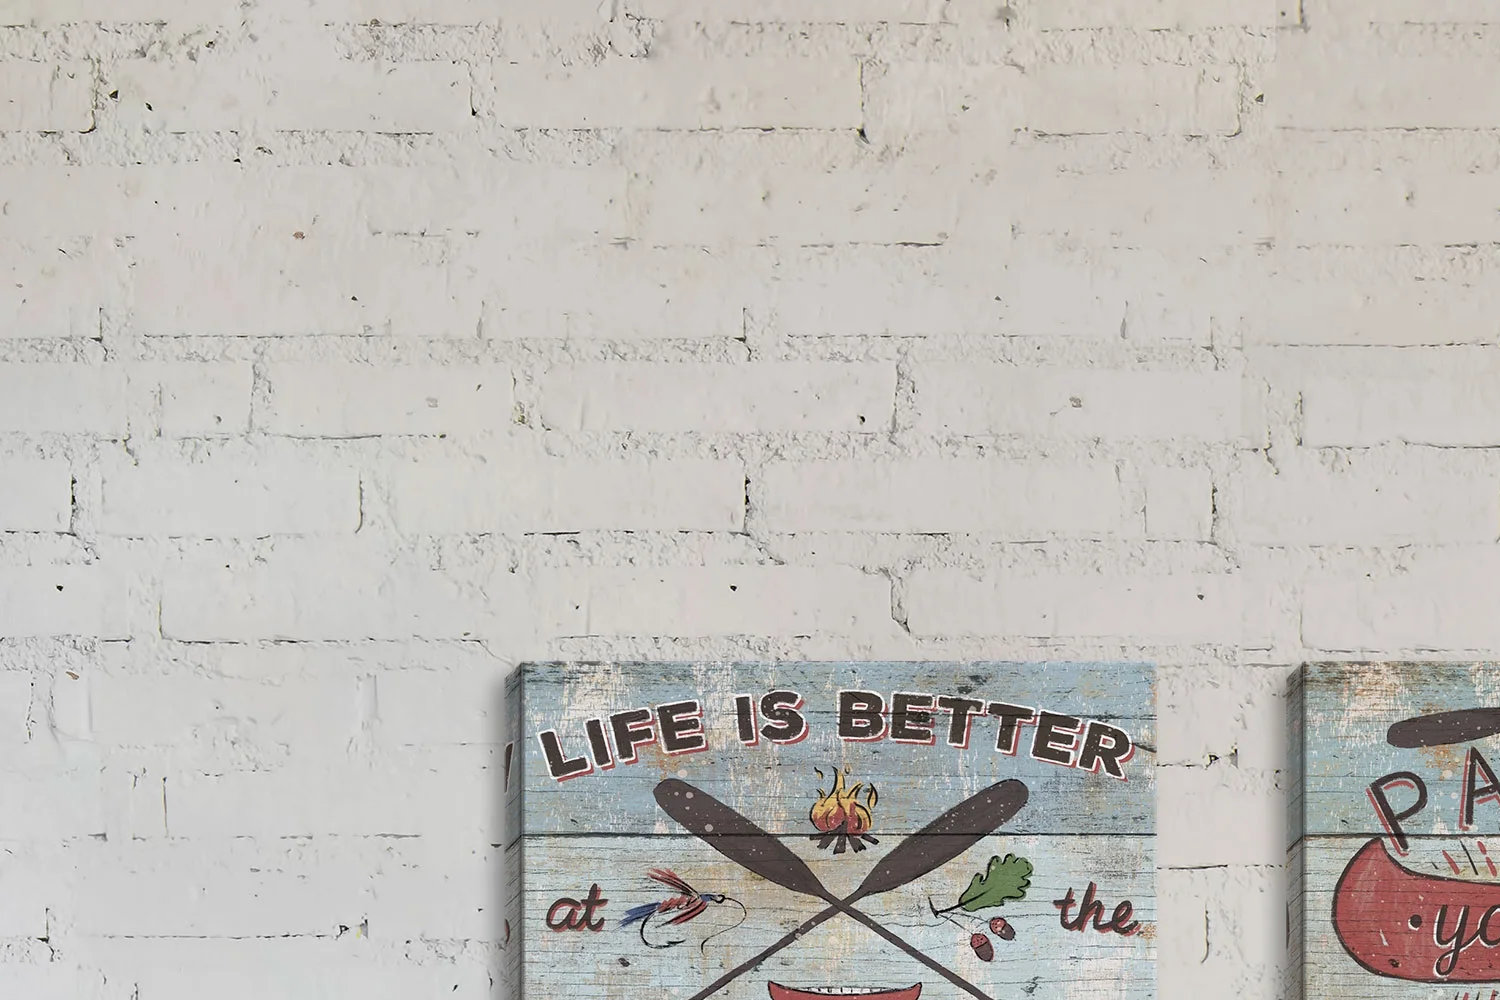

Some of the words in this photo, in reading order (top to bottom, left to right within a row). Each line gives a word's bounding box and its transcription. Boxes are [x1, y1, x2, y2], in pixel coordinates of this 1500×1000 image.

[538, 699, 706, 781] LIFE
[736, 689, 808, 747] IS
[836, 689, 1135, 782] BETTER
[546, 883, 608, 932] at
[1053, 881, 1141, 936] the
